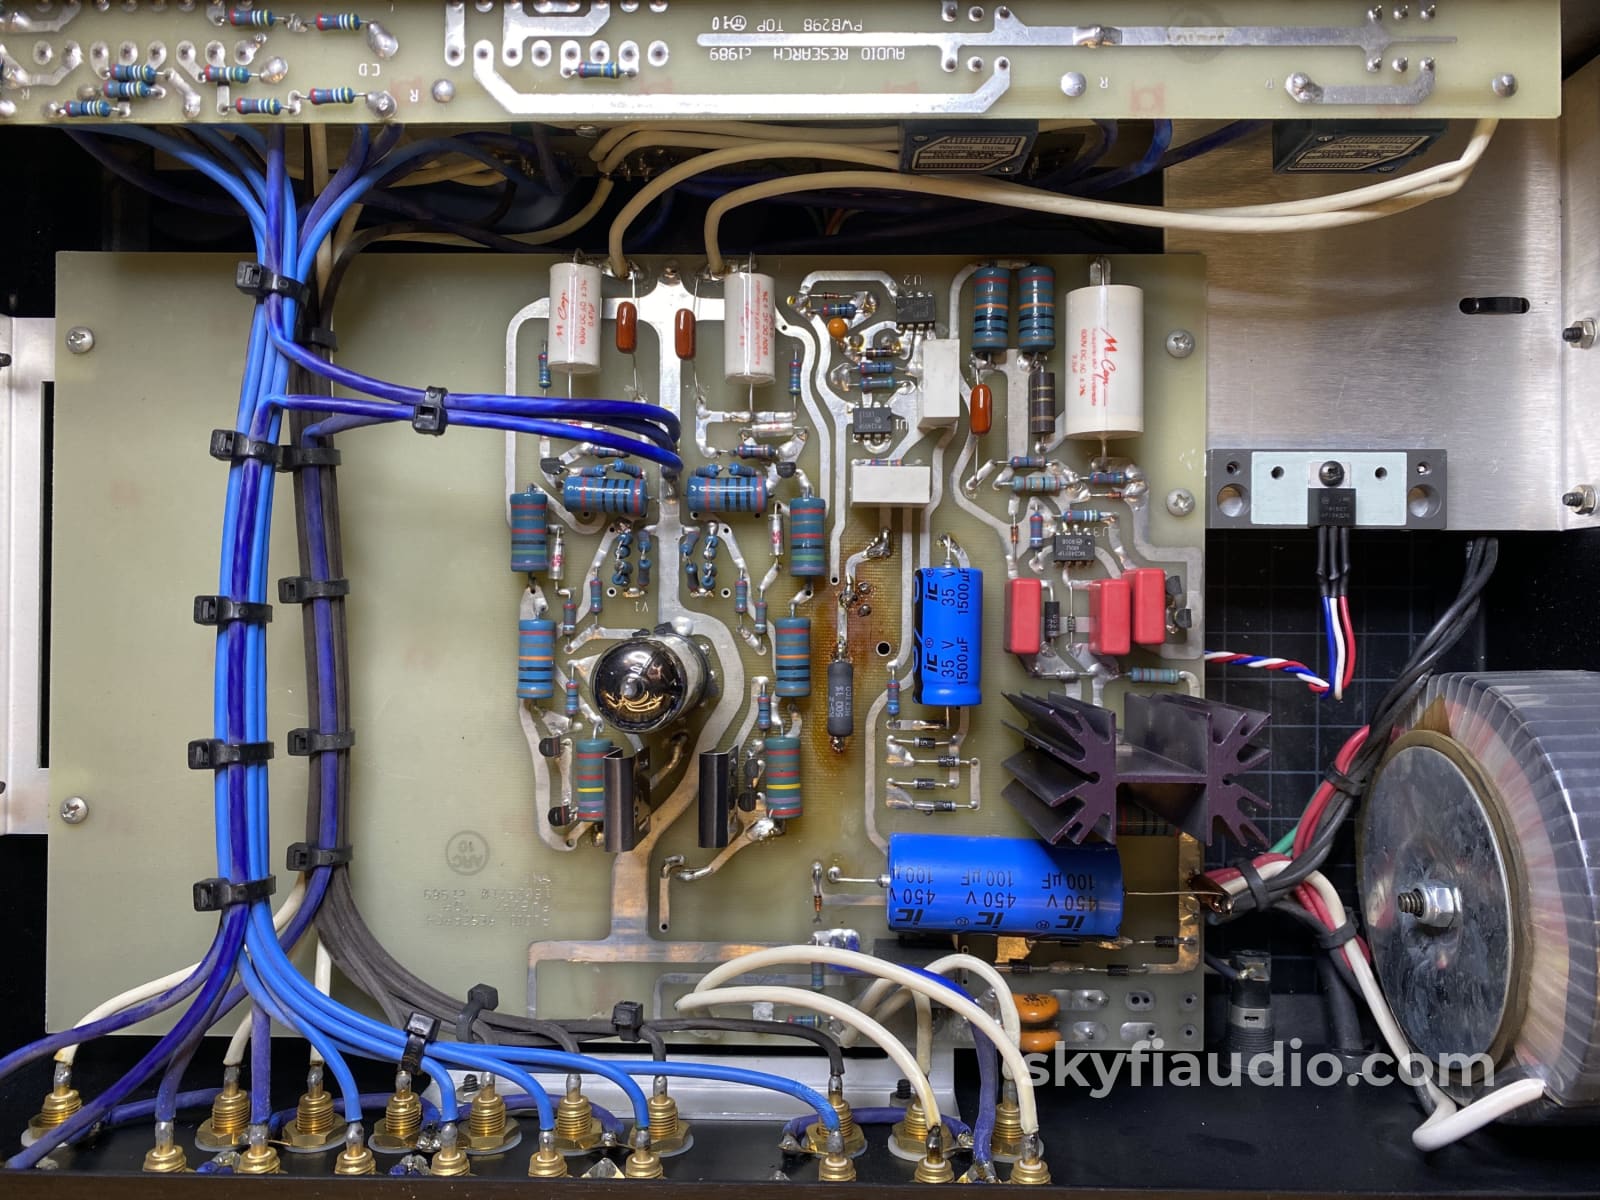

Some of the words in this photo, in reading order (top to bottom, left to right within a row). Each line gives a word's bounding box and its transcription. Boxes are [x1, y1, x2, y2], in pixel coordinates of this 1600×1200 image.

[756, 18, 784, 32] TOP
[803, 18, 863, 32] PWB298
[772, 47, 849, 60] RESEARCH
[861, 47, 905, 60] AUDIO
[358, 63, 380, 77] CD
[1099, 76, 1109, 88] R
[409, 88, 419, 102] R
[903, 274, 922, 288] U2
[896, 418, 908, 430] U1
[942, 589, 955, 606] 35
[942, 640, 954, 650] V
[942, 660, 955, 678] 35
[906, 868, 933, 884] 100
[986, 870, 1014, 886] 100
[1066, 874, 1096, 890] 100
[902, 888, 936, 905] 450
[983, 892, 1016, 908] 450
[1065, 895, 1097, 911] 450
